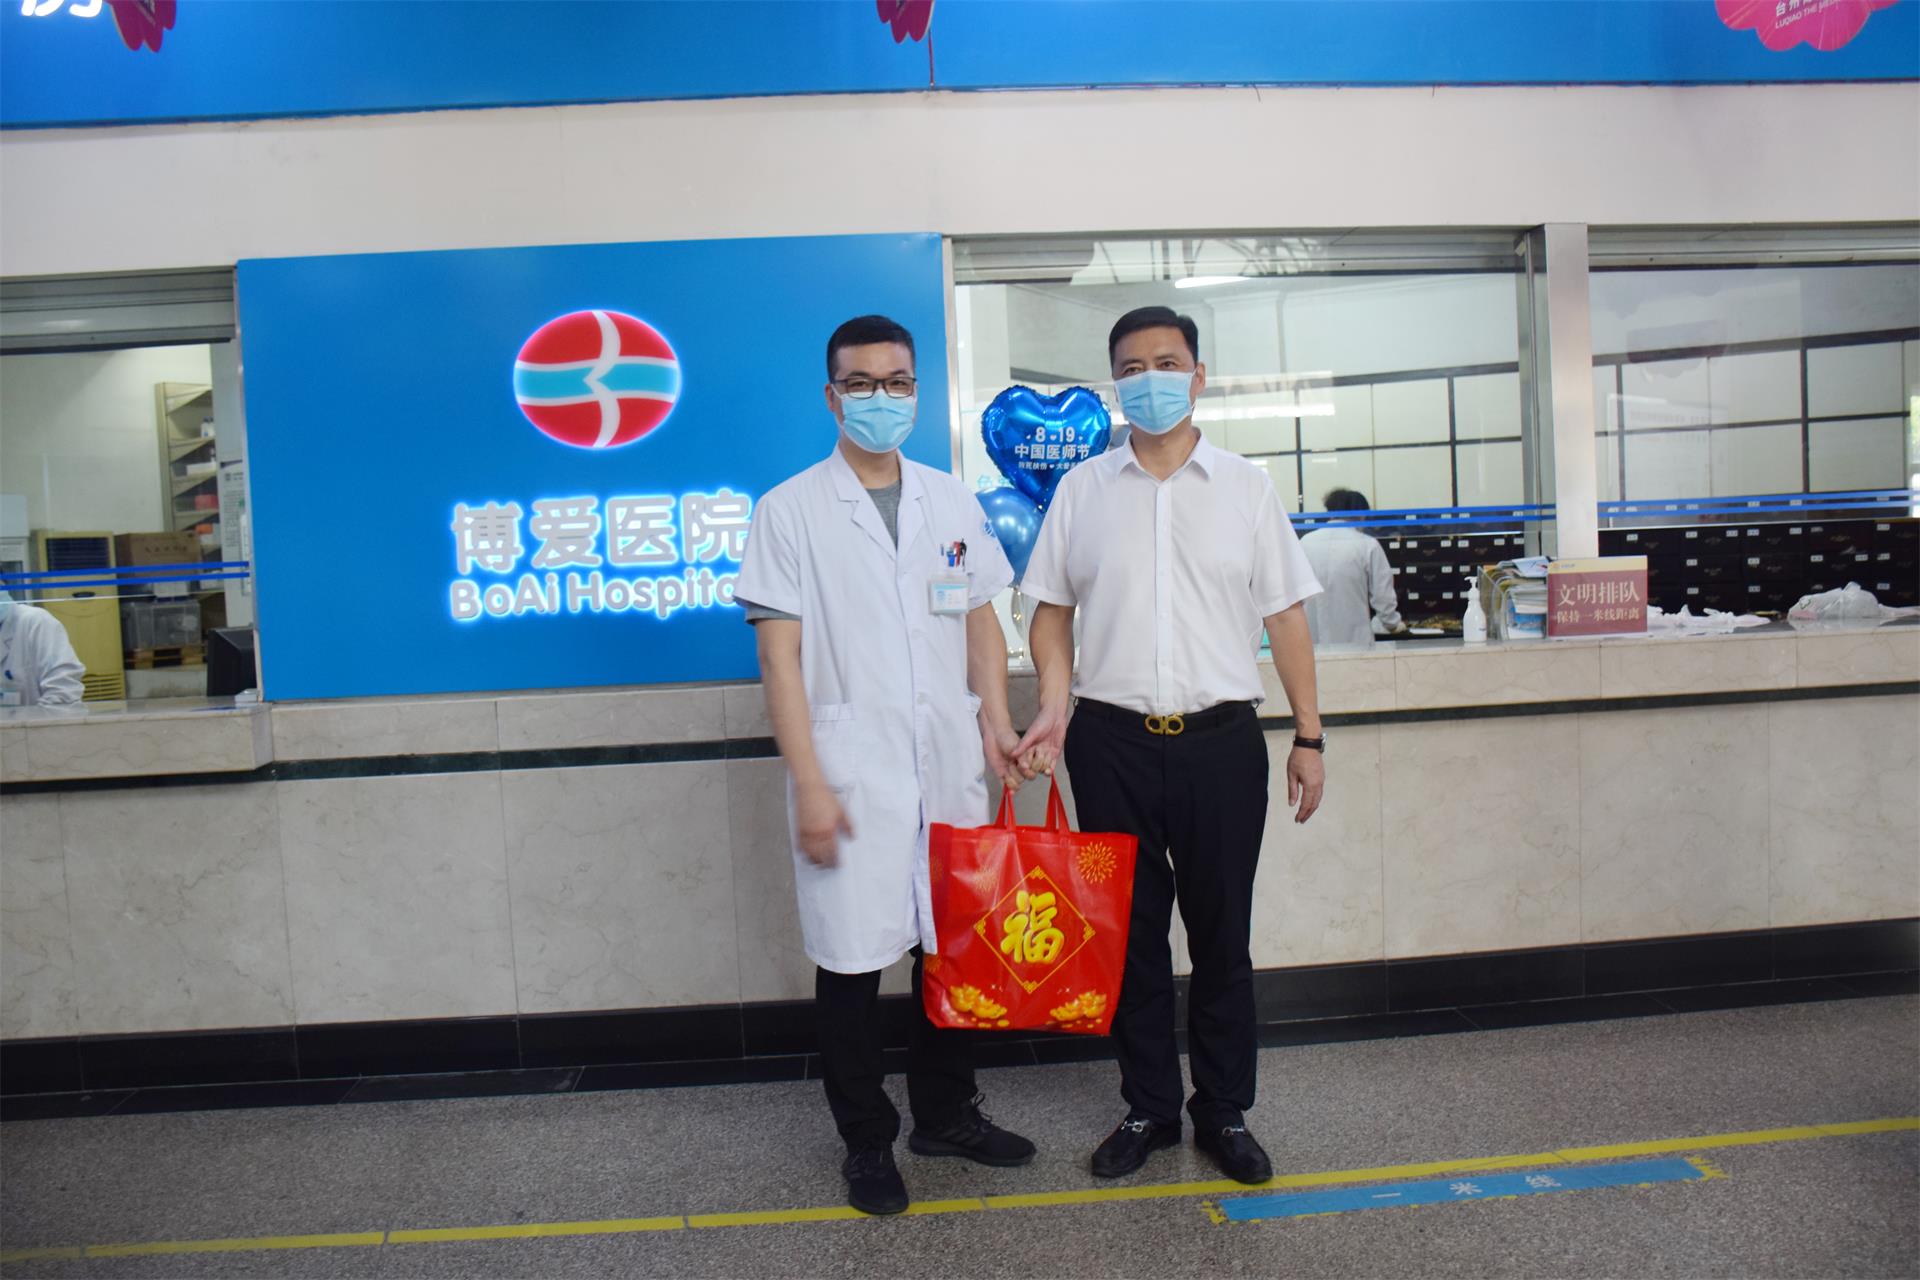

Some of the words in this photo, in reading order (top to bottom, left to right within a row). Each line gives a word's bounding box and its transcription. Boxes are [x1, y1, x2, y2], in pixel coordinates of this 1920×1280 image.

[1776, 12, 1803, 29] LUQIAO
[1014, 443, 1090, 460] 中国医师节
[452, 488, 752, 573] 博爱医院
[451, 573, 559, 619] BoAi
[567, 567, 739, 618] Hospita
[1557, 580, 1640, 607] 文明排队
[1556, 607, 1640, 624] 保持一米线距离
[1000, 890, 1065, 964] 福
